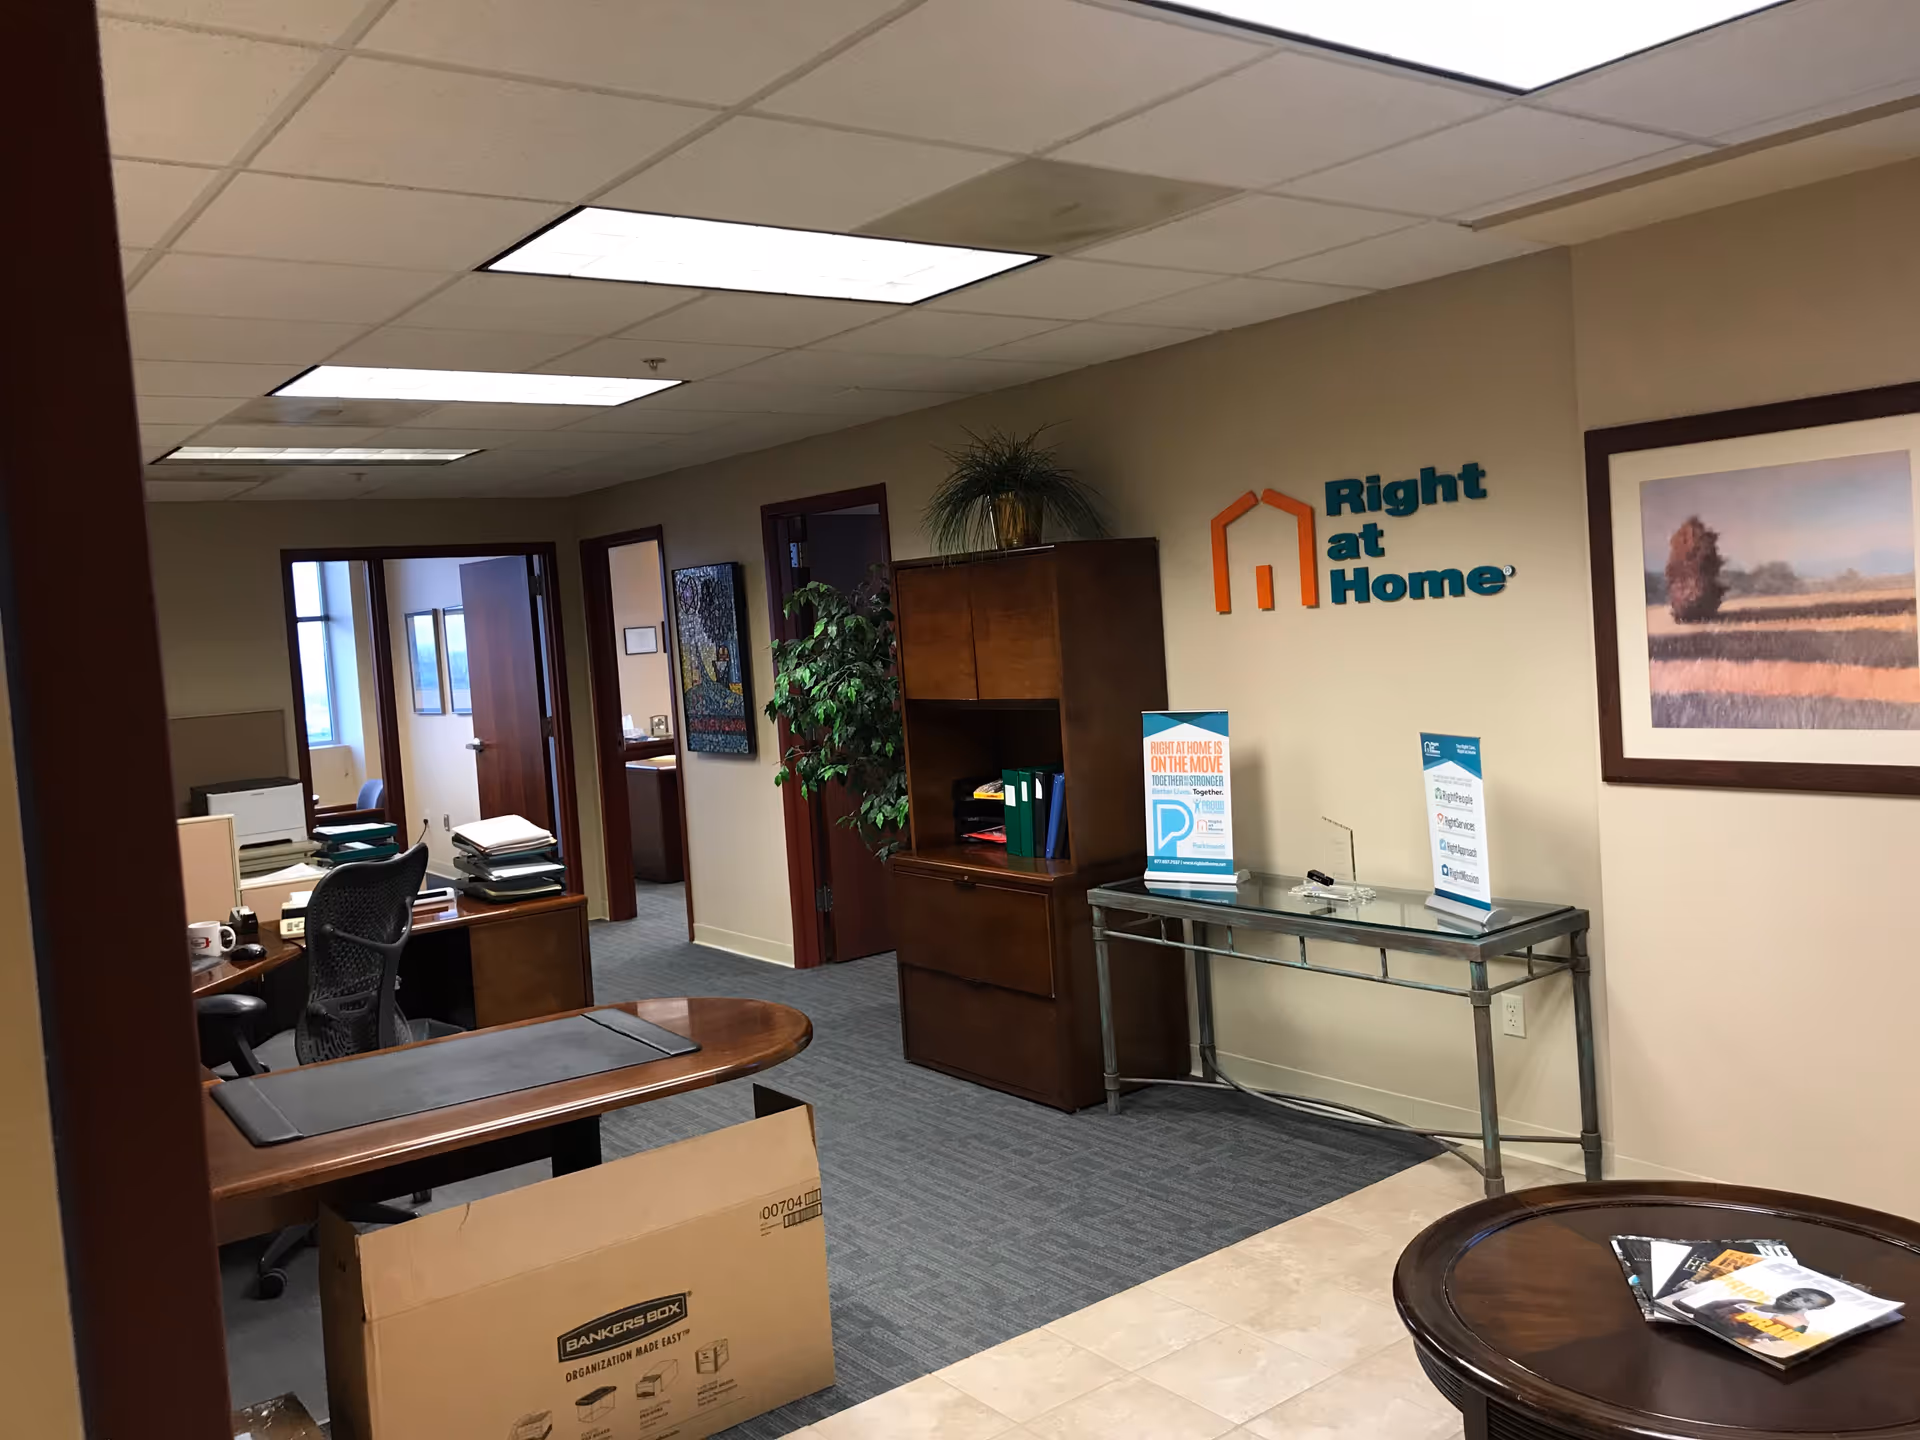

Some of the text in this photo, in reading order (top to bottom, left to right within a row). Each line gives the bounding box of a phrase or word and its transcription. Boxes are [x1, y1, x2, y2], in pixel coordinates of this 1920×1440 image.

[1325, 462, 1487, 516] Right
[1327, 523, 1385, 561] at
[1151, 741, 1223, 755] RIGHT AT HOME IS
[1151, 756, 1223, 773] ON THE MOVE
[1152, 775, 1184, 787] TOGETHER
[1189, 775, 1224, 787] STRONGER
[1193, 788, 1224, 797] Together.
[1442, 790, 1473, 805] RightPeople
[1445, 816, 1475, 832] RightServices
[1447, 842, 1477, 858] RightApproach
[1449, 868, 1479, 884] RightMission
[566, 1301, 681, 1352] BANKERS BOX
[565, 1350, 632, 1383] ORGANIZATION
[635, 1340, 659, 1358] MADE
